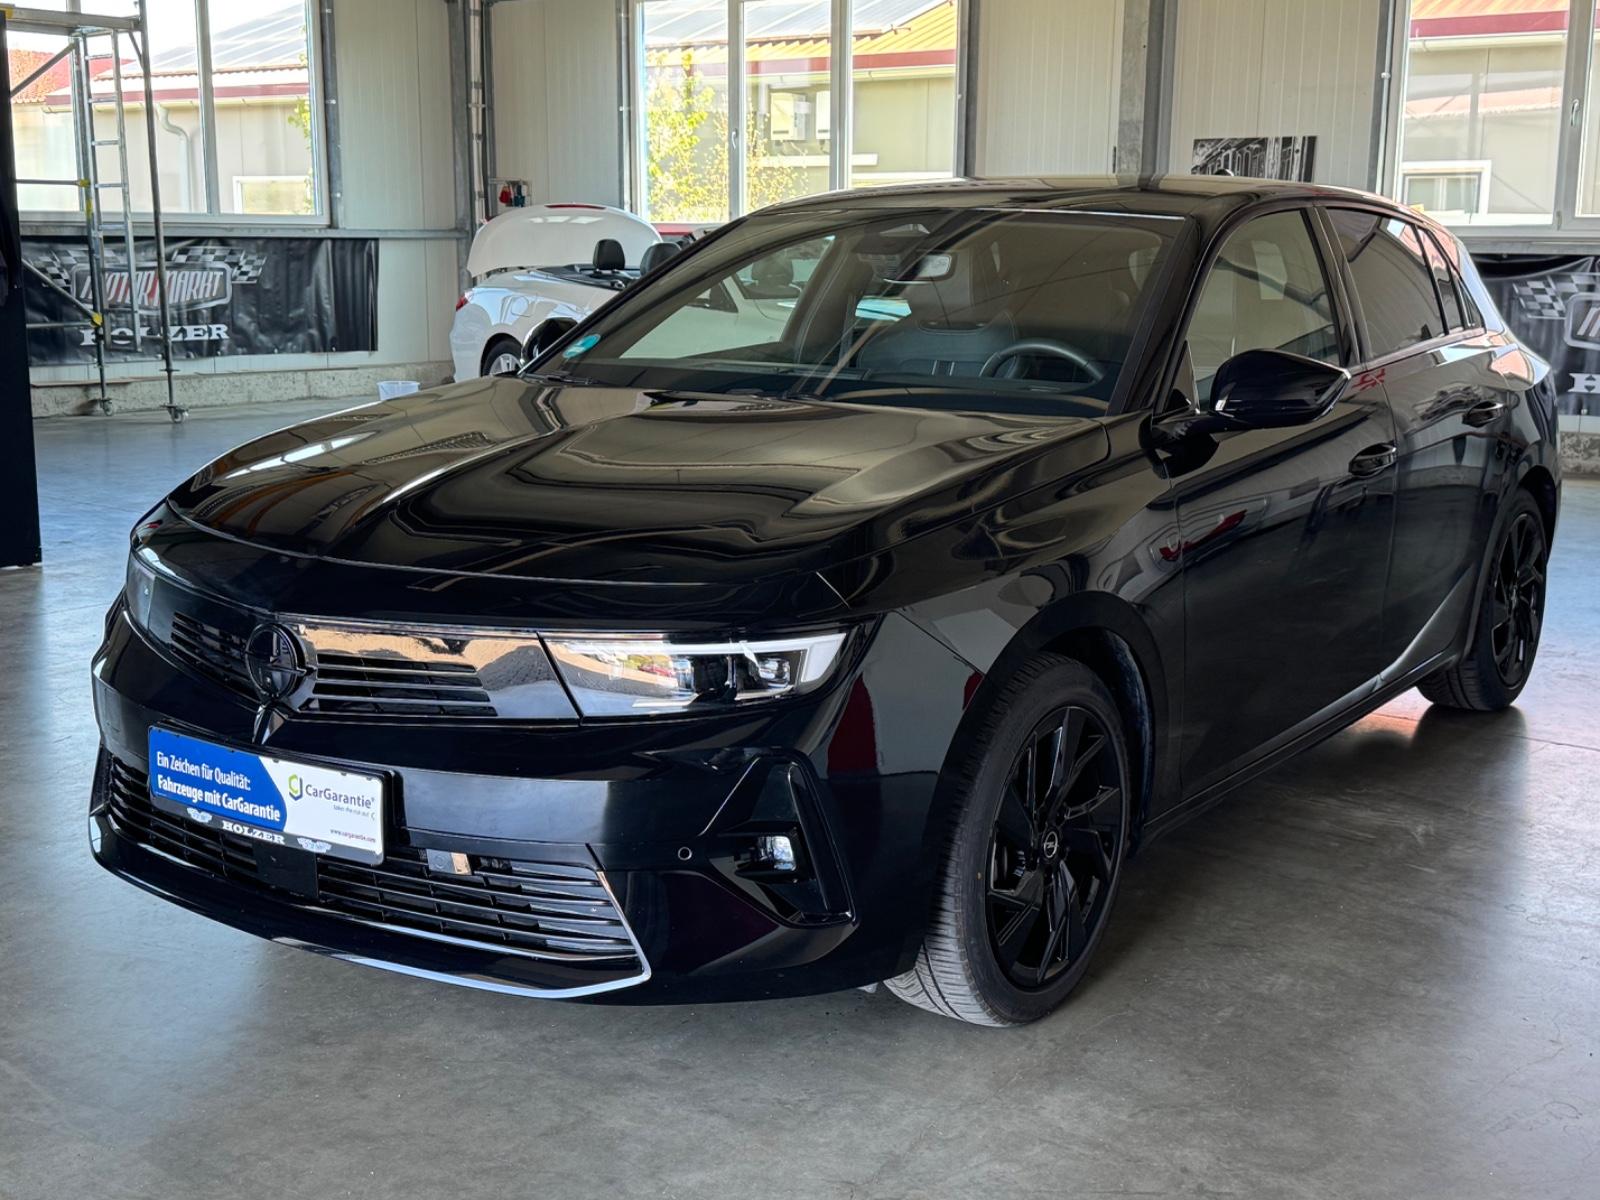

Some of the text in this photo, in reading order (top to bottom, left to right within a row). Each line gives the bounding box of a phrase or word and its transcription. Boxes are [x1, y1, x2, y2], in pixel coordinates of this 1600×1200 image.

[156, 751, 252, 791] Ein Zeichen für Qualität:
[157, 774, 203, 803] Fahrzeuge
[204, 790, 221, 806] mit
[222, 792, 281, 822] CarGarantie
[222, 820, 285, 845] HOLZER
